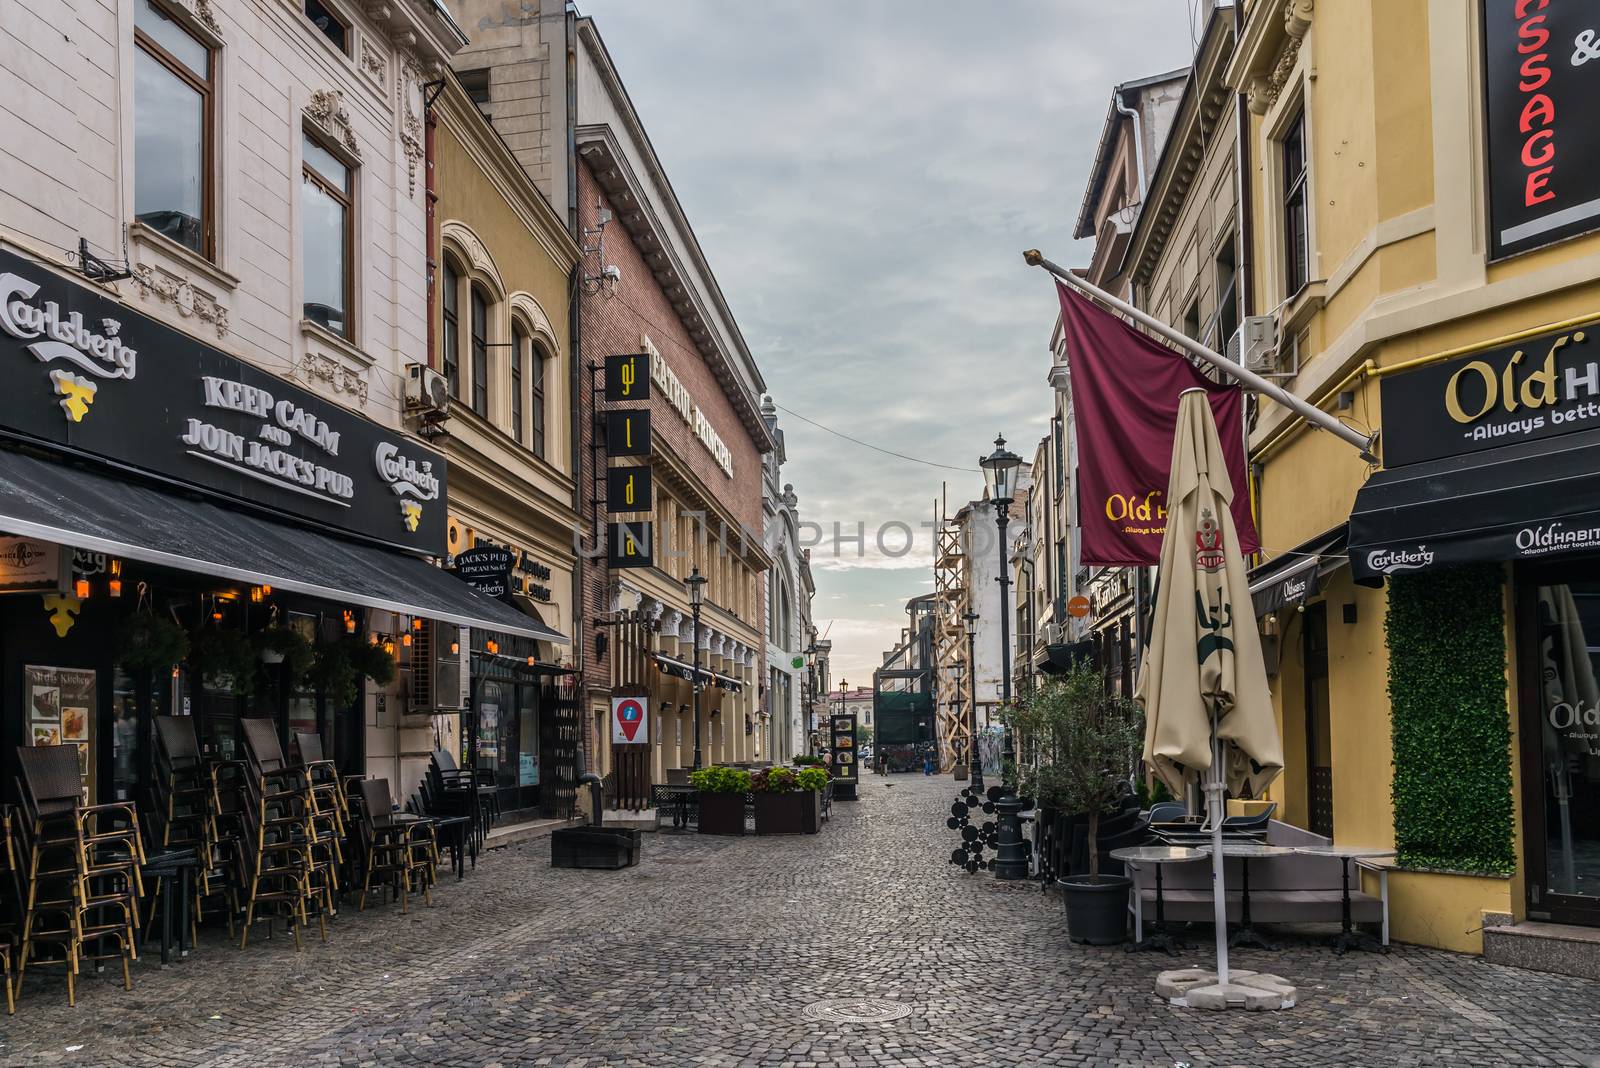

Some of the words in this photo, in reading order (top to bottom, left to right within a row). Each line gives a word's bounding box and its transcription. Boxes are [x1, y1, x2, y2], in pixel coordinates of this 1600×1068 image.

[0, 272, 137, 380] Carlsberg
[1446, 336, 1569, 424] Old
[202, 376, 274, 419] KEEP
[275, 400, 341, 456] CALM
[641, 334, 693, 428] TEATRUL
[694, 405, 733, 480] PRINCIPAL
[1551, 403, 1600, 425] bett
[259, 424, 291, 447] AND
[182, 418, 245, 462] JOIN
[245, 441, 314, 486] JACK'S
[314, 464, 354, 498] PUB
[375, 441, 439, 499] Carlsberg
[1106, 491, 1155, 521] Old
[1515, 522, 1557, 549] Old
[1549, 542, 1571, 552] better
[460, 553, 488, 566] JACK'S
[490, 553, 508, 562] PUB
[1367, 548, 1434, 572] Carlsberg
